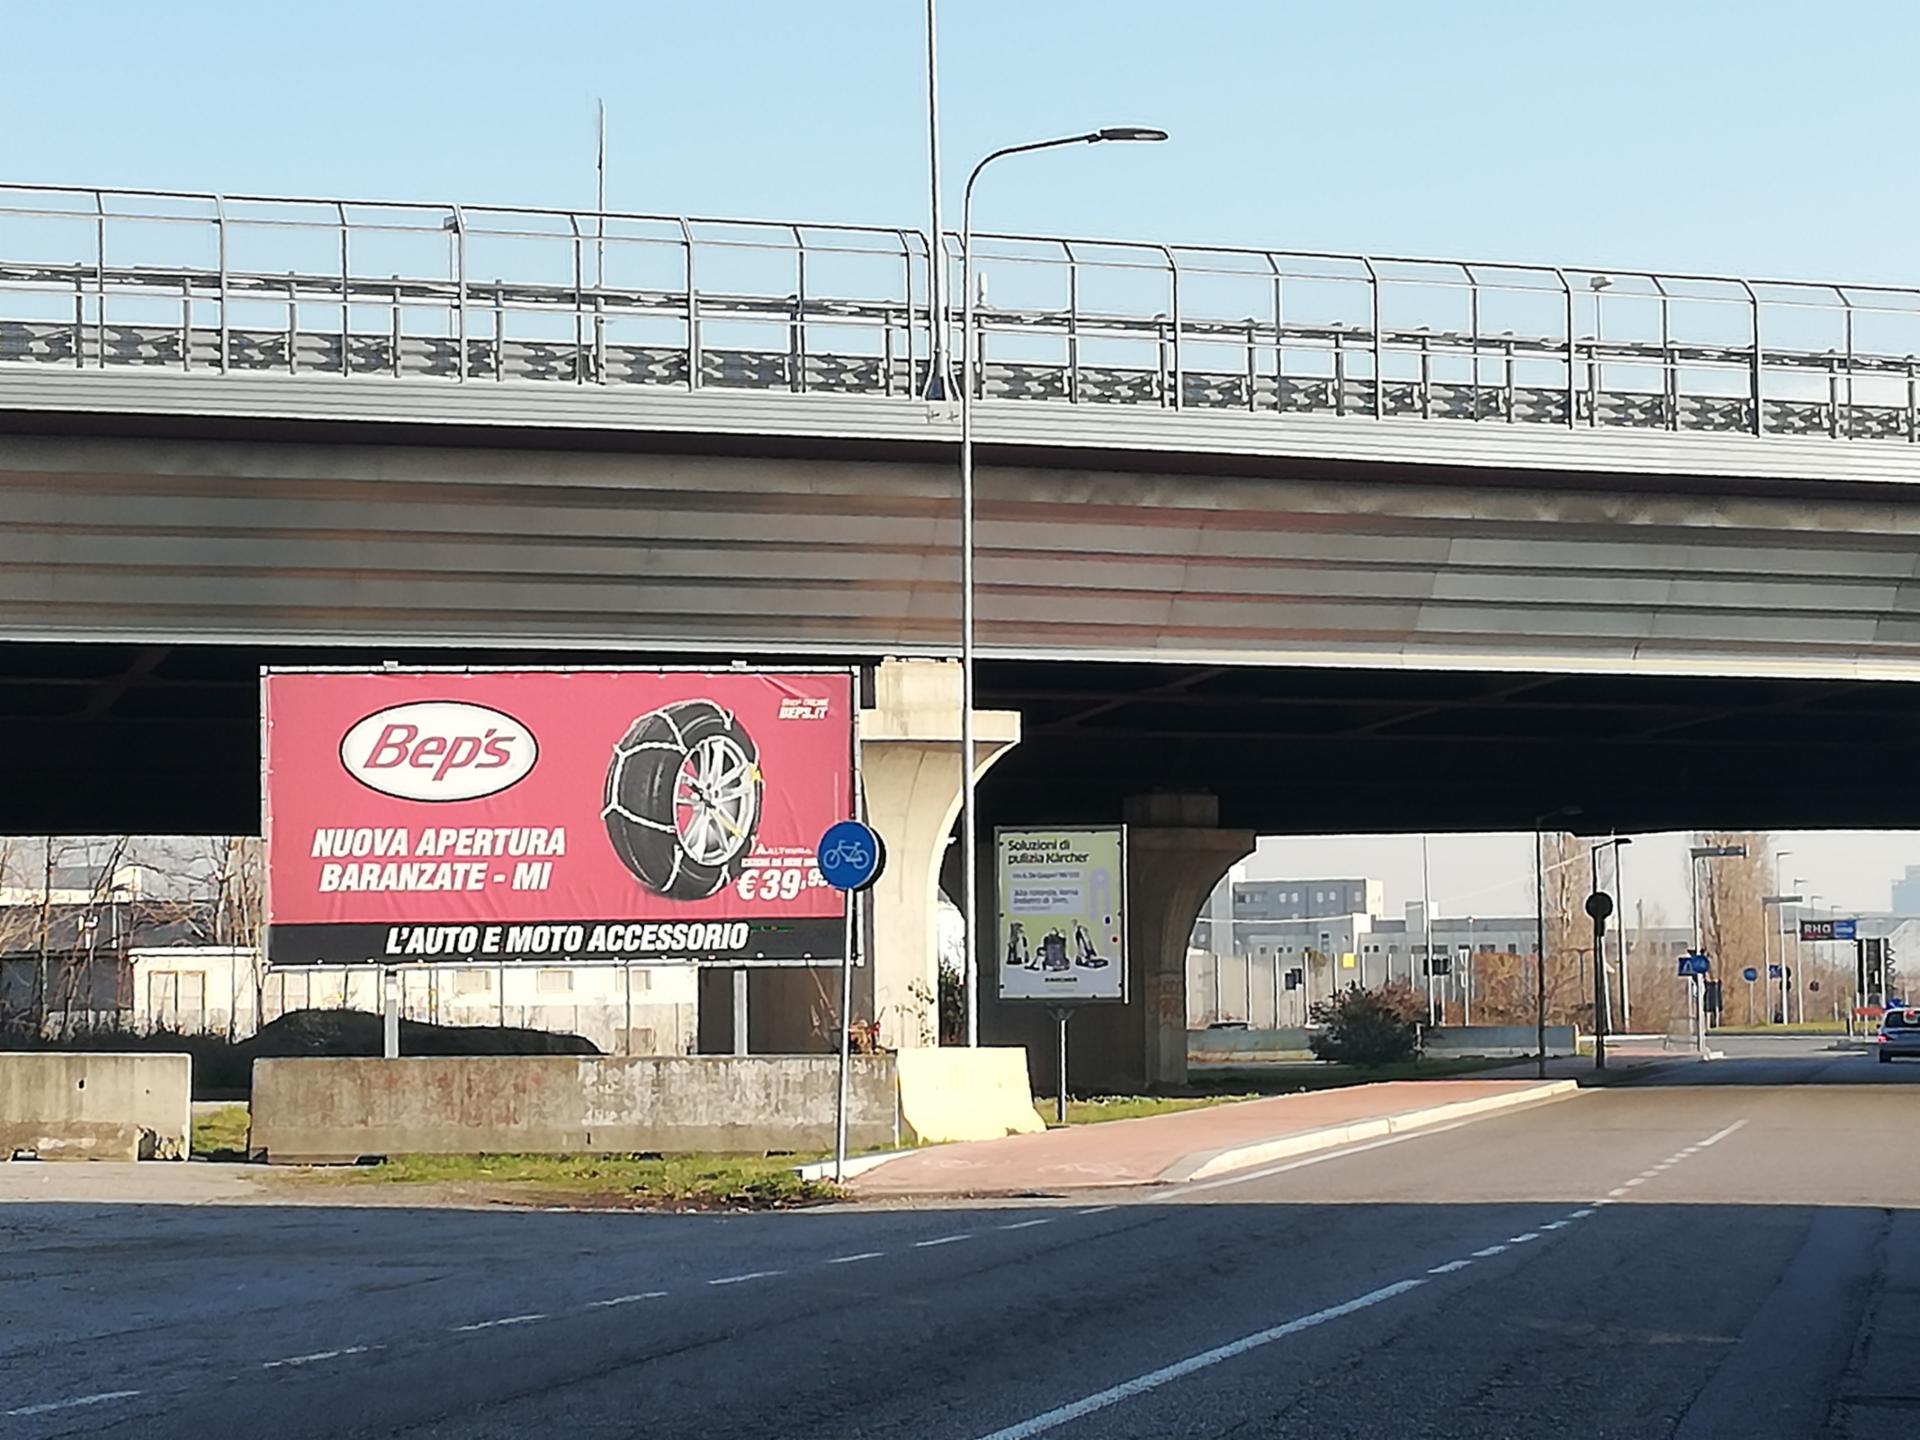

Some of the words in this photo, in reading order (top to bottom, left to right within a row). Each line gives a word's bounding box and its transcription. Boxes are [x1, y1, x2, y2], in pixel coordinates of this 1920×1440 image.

[363, 723, 516, 781] Bep's
[311, 828, 408, 857] NUOVA
[415, 827, 566, 856] APERTURA
[1008, 840, 1057, 851] Soluzioni
[1059, 839, 1070, 851] di
[1008, 853, 1044, 865] pulizia
[319, 863, 488, 892] BARANZATE
[493, 873, 506, 884] -
[512, 862, 552, 890] MI
[385, 926, 480, 954] L'AUTO
[482, 926, 501, 953] E
[504, 925, 586, 953] MOTO
[586, 923, 749, 952] ACCESSORIO
[1804, 923, 1832, 934] RHO
